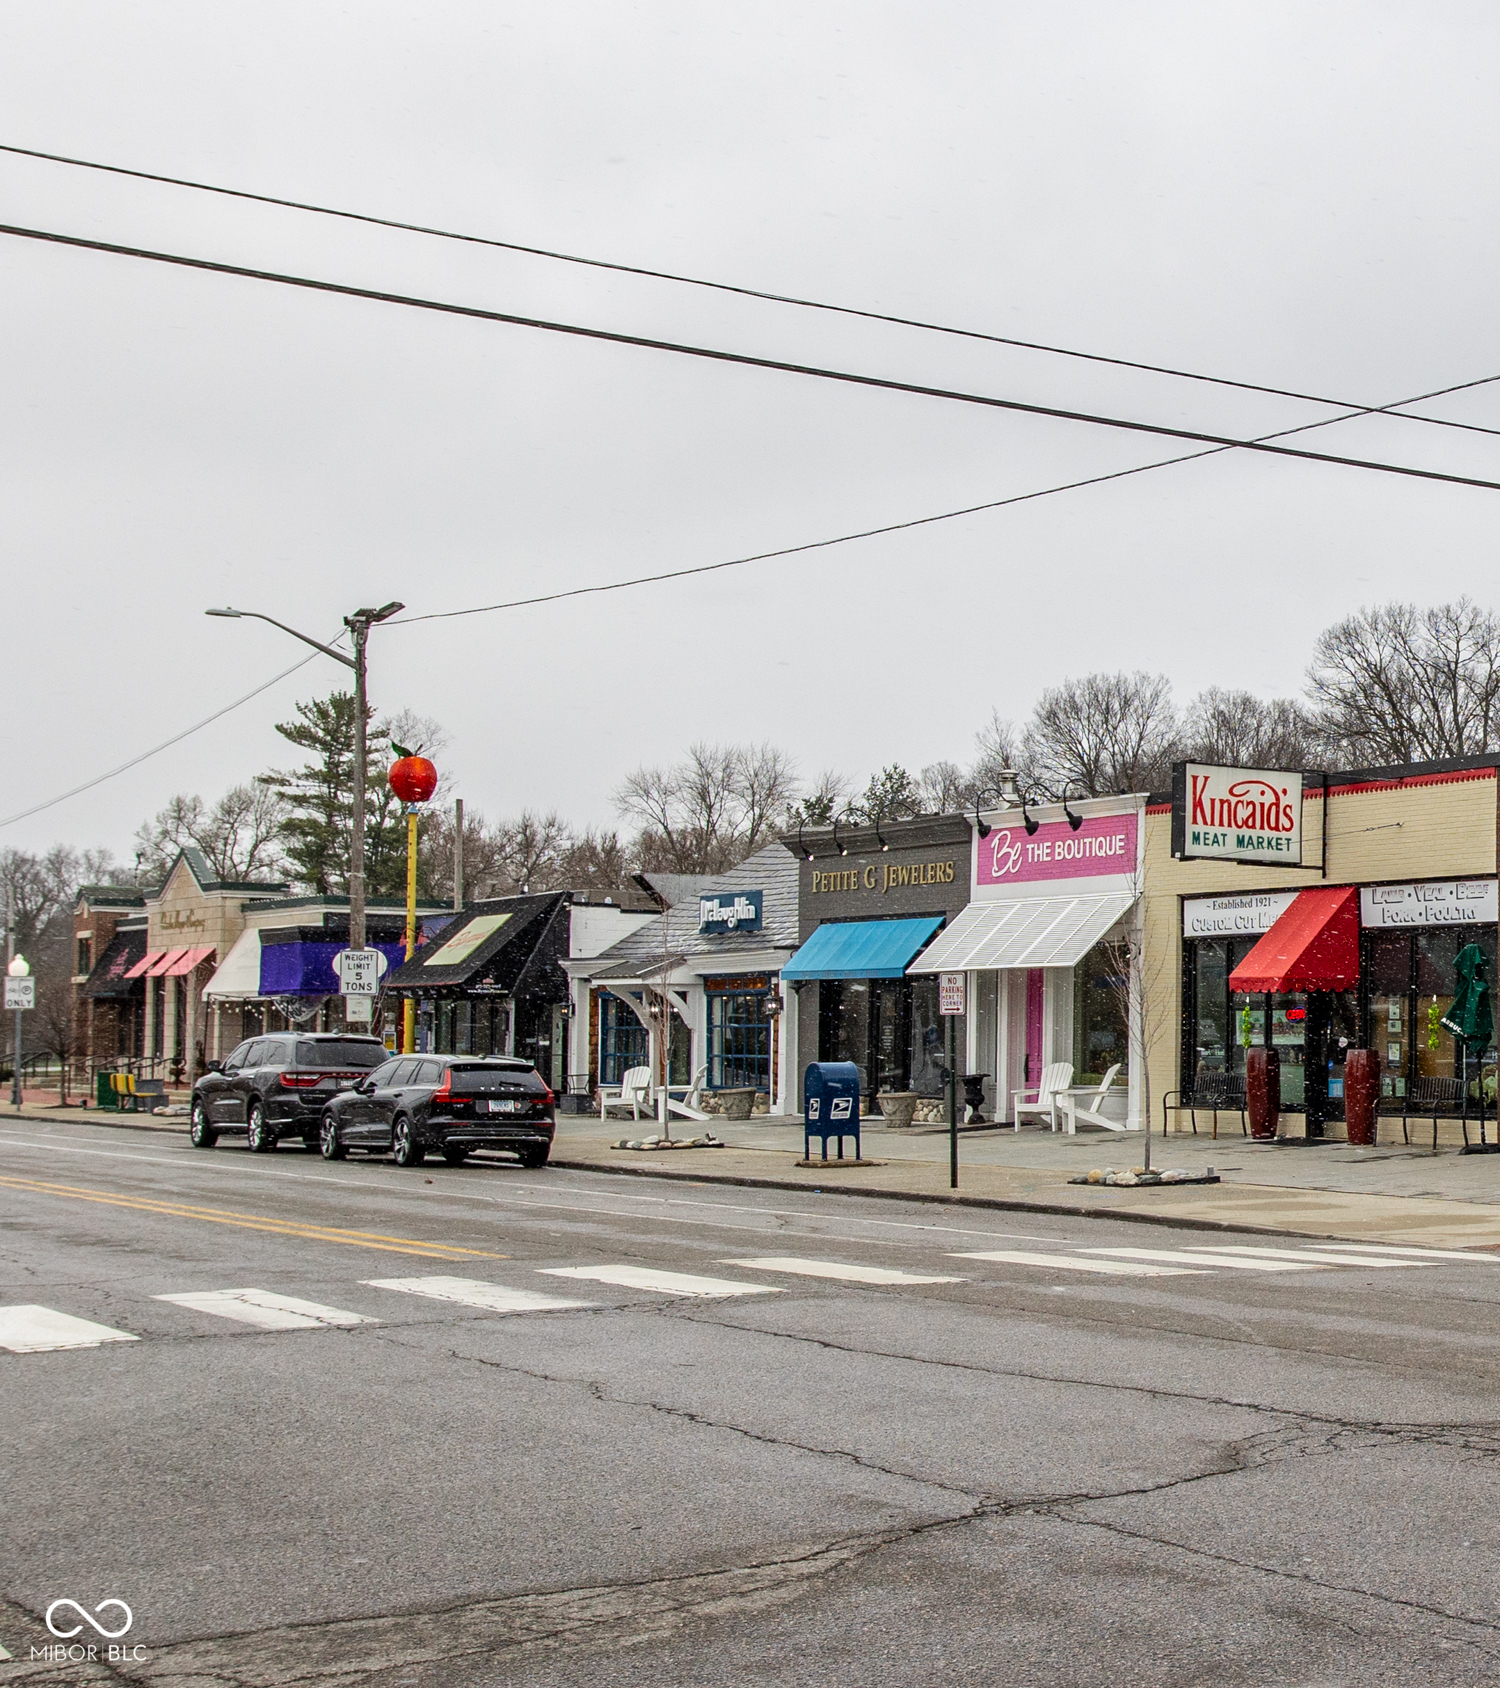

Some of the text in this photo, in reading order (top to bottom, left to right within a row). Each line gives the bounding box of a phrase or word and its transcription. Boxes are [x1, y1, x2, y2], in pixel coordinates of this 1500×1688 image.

[1191, 774, 1294, 833] Kincaid's
[1191, 831, 1292, 851] MEAT MARKET
[990, 830, 1126, 878] Be THE BOUTIQUE
[811, 861, 955, 893] PETITE G JEWELERS
[1414, 885, 1446, 902] VEAL
[1456, 883, 1489, 900] BEEF
[1212, 897, 1271, 910] Established 1921
[1234, 914, 1257, 930] CUT
[355, 972, 363, 981] 5
[947, 977, 957, 985] NO
[345, 982, 373, 991] TONS
[6, 999, 32, 1007] ONLY
